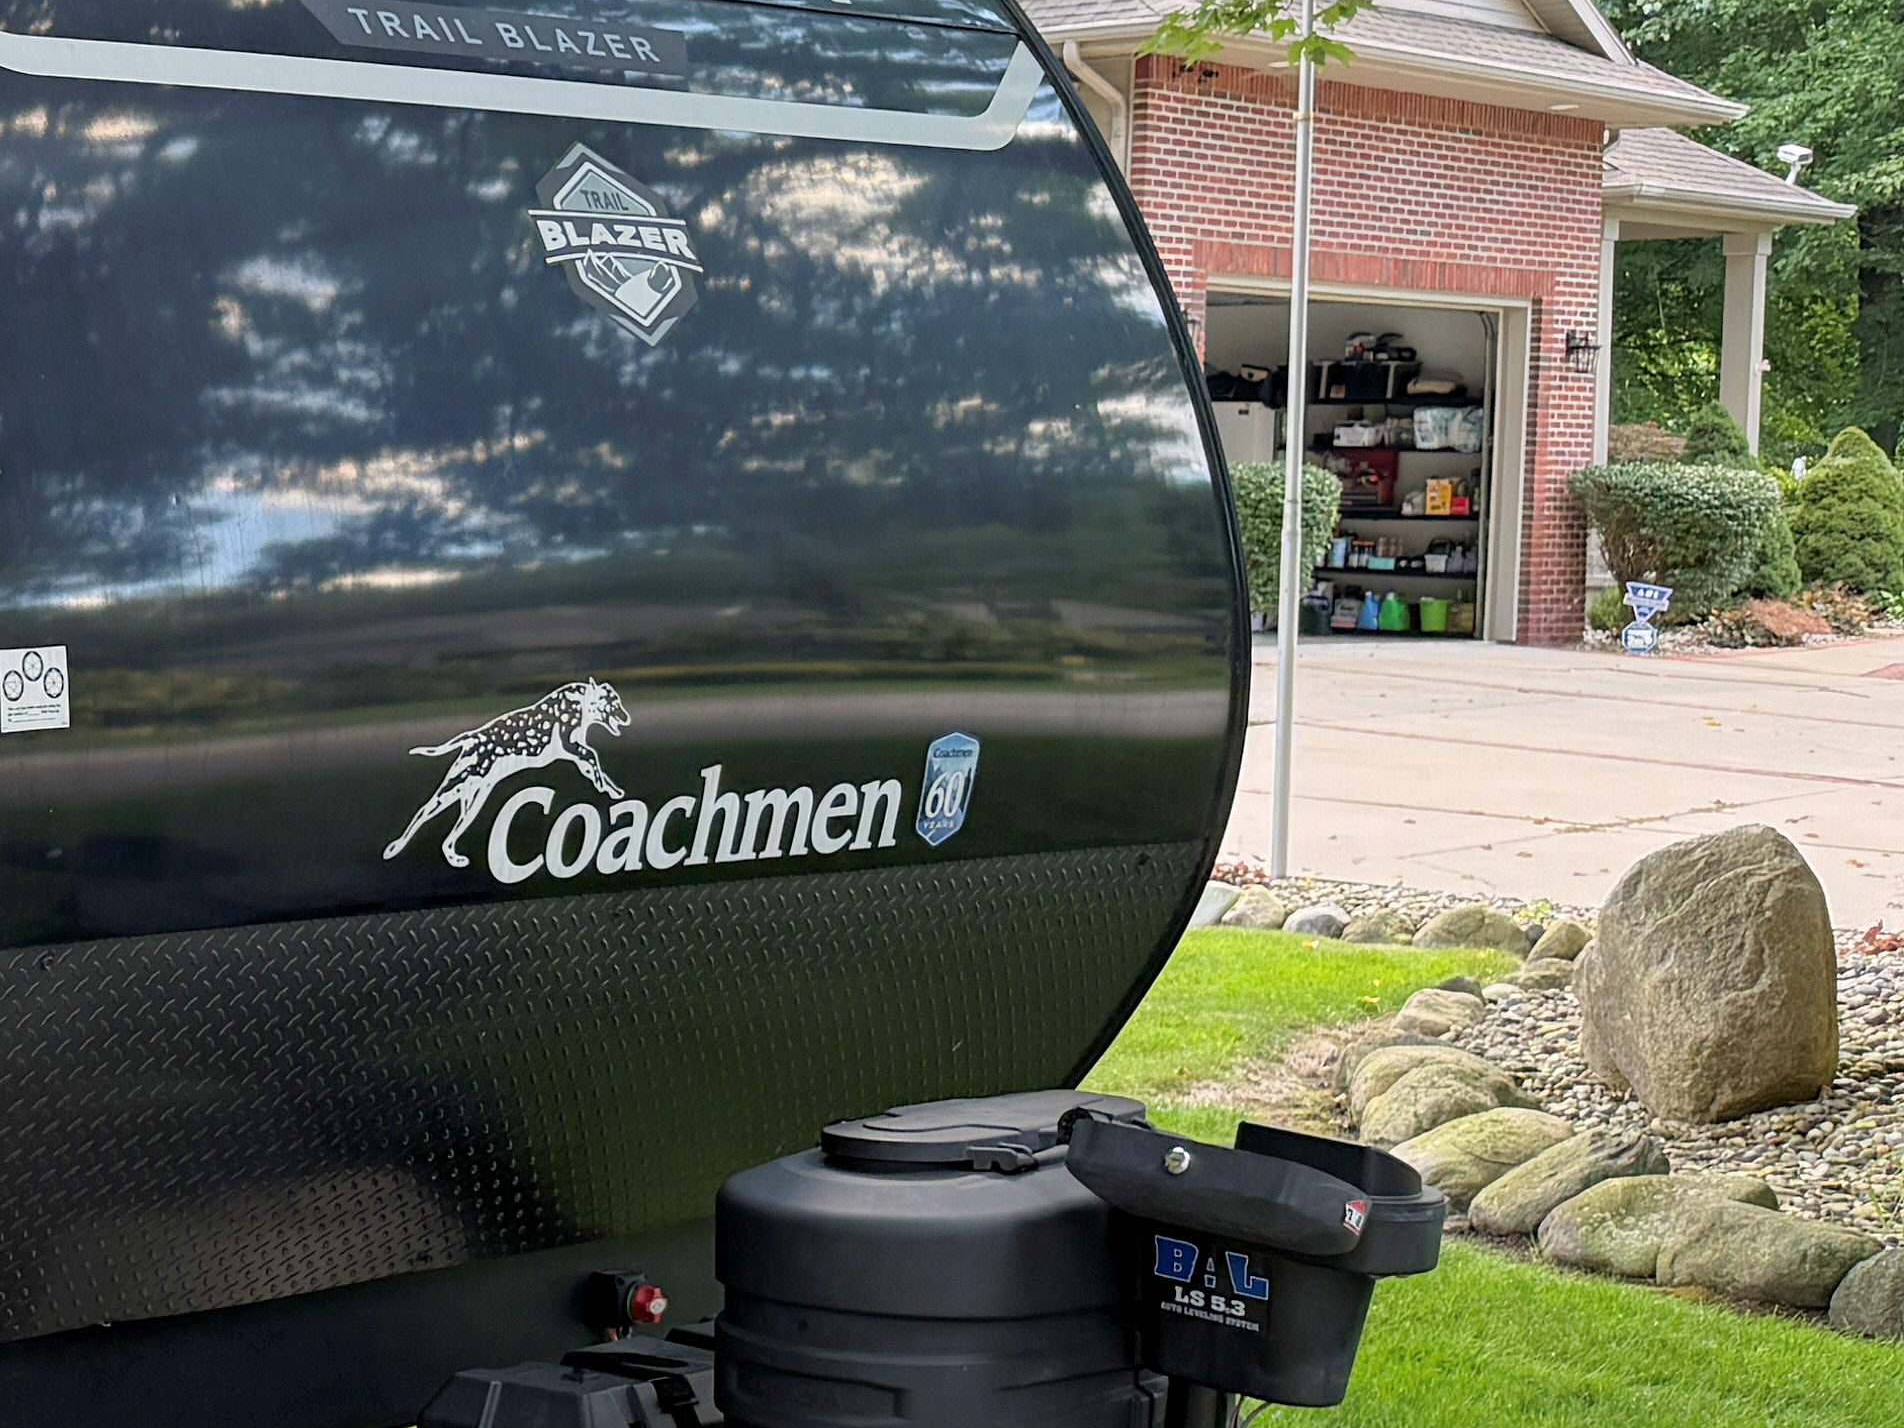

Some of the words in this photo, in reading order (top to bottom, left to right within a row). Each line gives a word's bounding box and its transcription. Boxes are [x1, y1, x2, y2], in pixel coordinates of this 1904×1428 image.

[347, 7, 483, 46] TRAIL
[495, 21, 661, 63] BLAZER
[580, 189, 629, 211] TRAIL
[536, 220, 697, 260] BLAZER
[924, 771, 966, 819] 60
[487, 764, 903, 885] Coachmen
[1174, 1285, 1205, 1308] LS
[1210, 1295, 1247, 1317] 5.3
